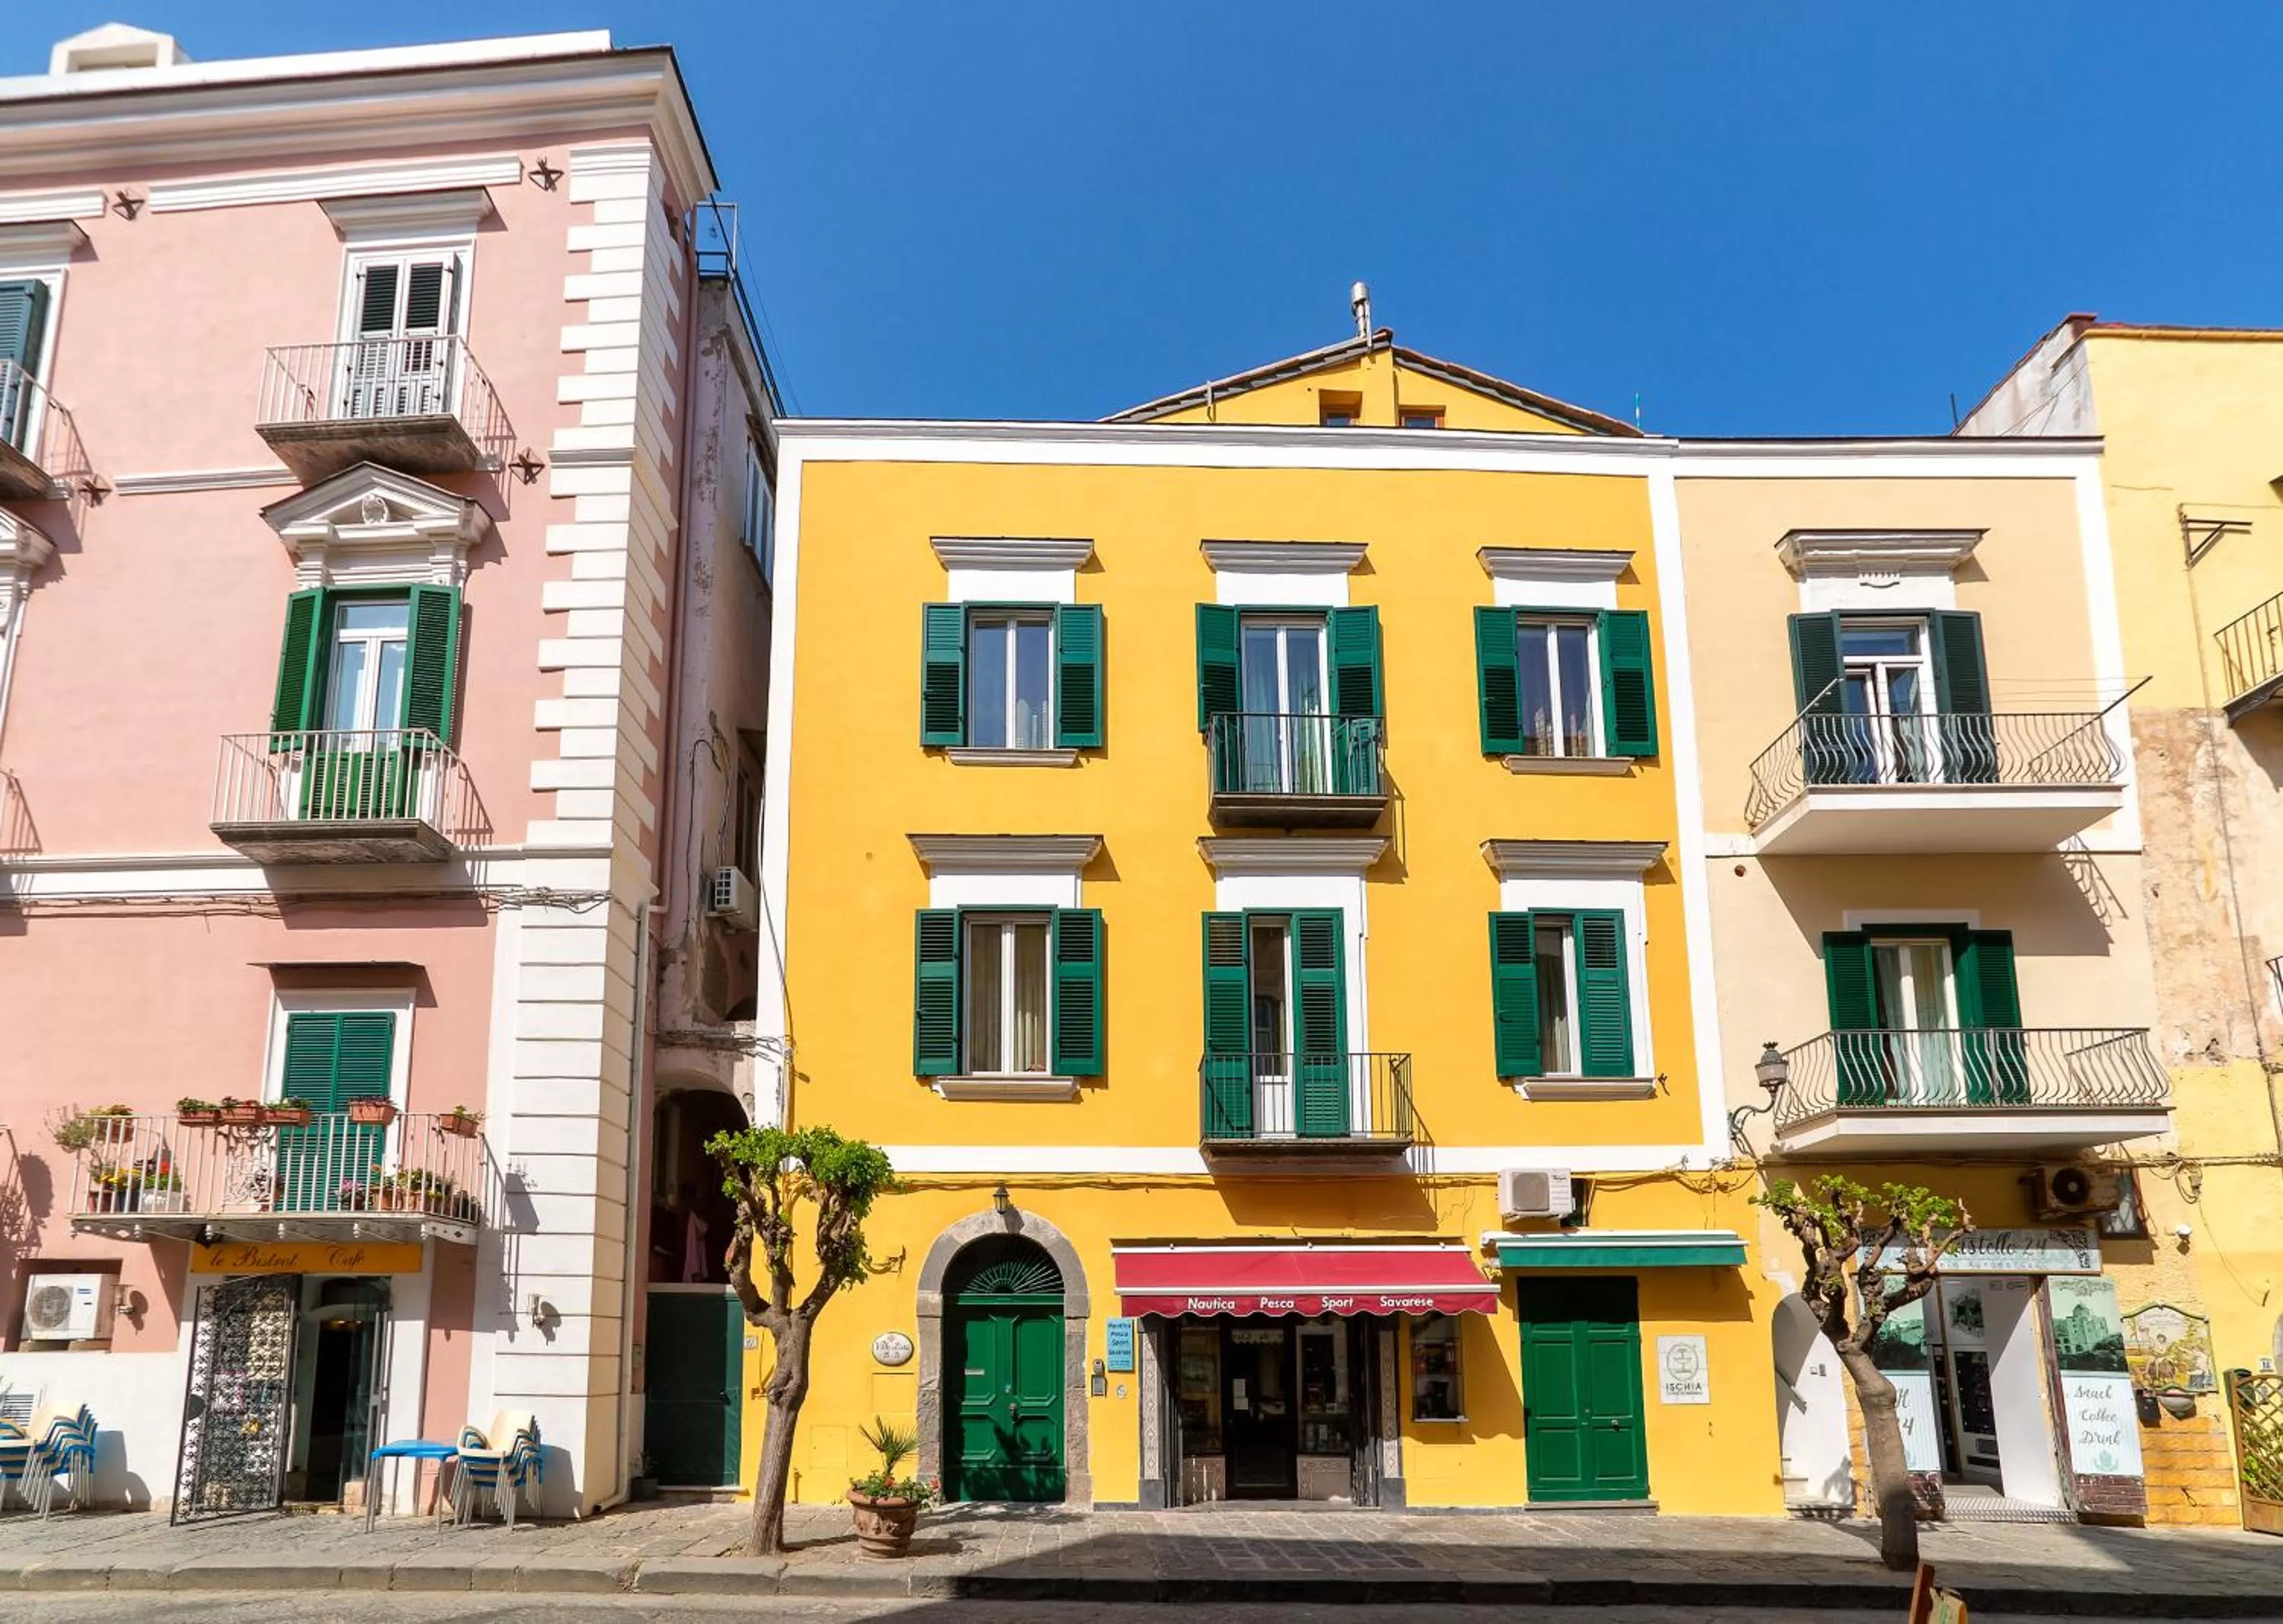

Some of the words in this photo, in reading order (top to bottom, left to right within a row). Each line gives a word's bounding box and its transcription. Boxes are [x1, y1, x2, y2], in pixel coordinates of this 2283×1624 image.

[2023, 1237, 2048, 1256] 24
[232, 1244, 299, 1267] Bistrot
[1187, 1298, 1235, 1310] Nautica
[1259, 1298, 1294, 1308] Pesca
[1321, 1296, 1354, 1310] Sport
[1380, 1296, 1434, 1307] Savarese
[1666, 1381, 1702, 1392] ISCHIA
[2081, 1407, 2117, 1422] Coffee
